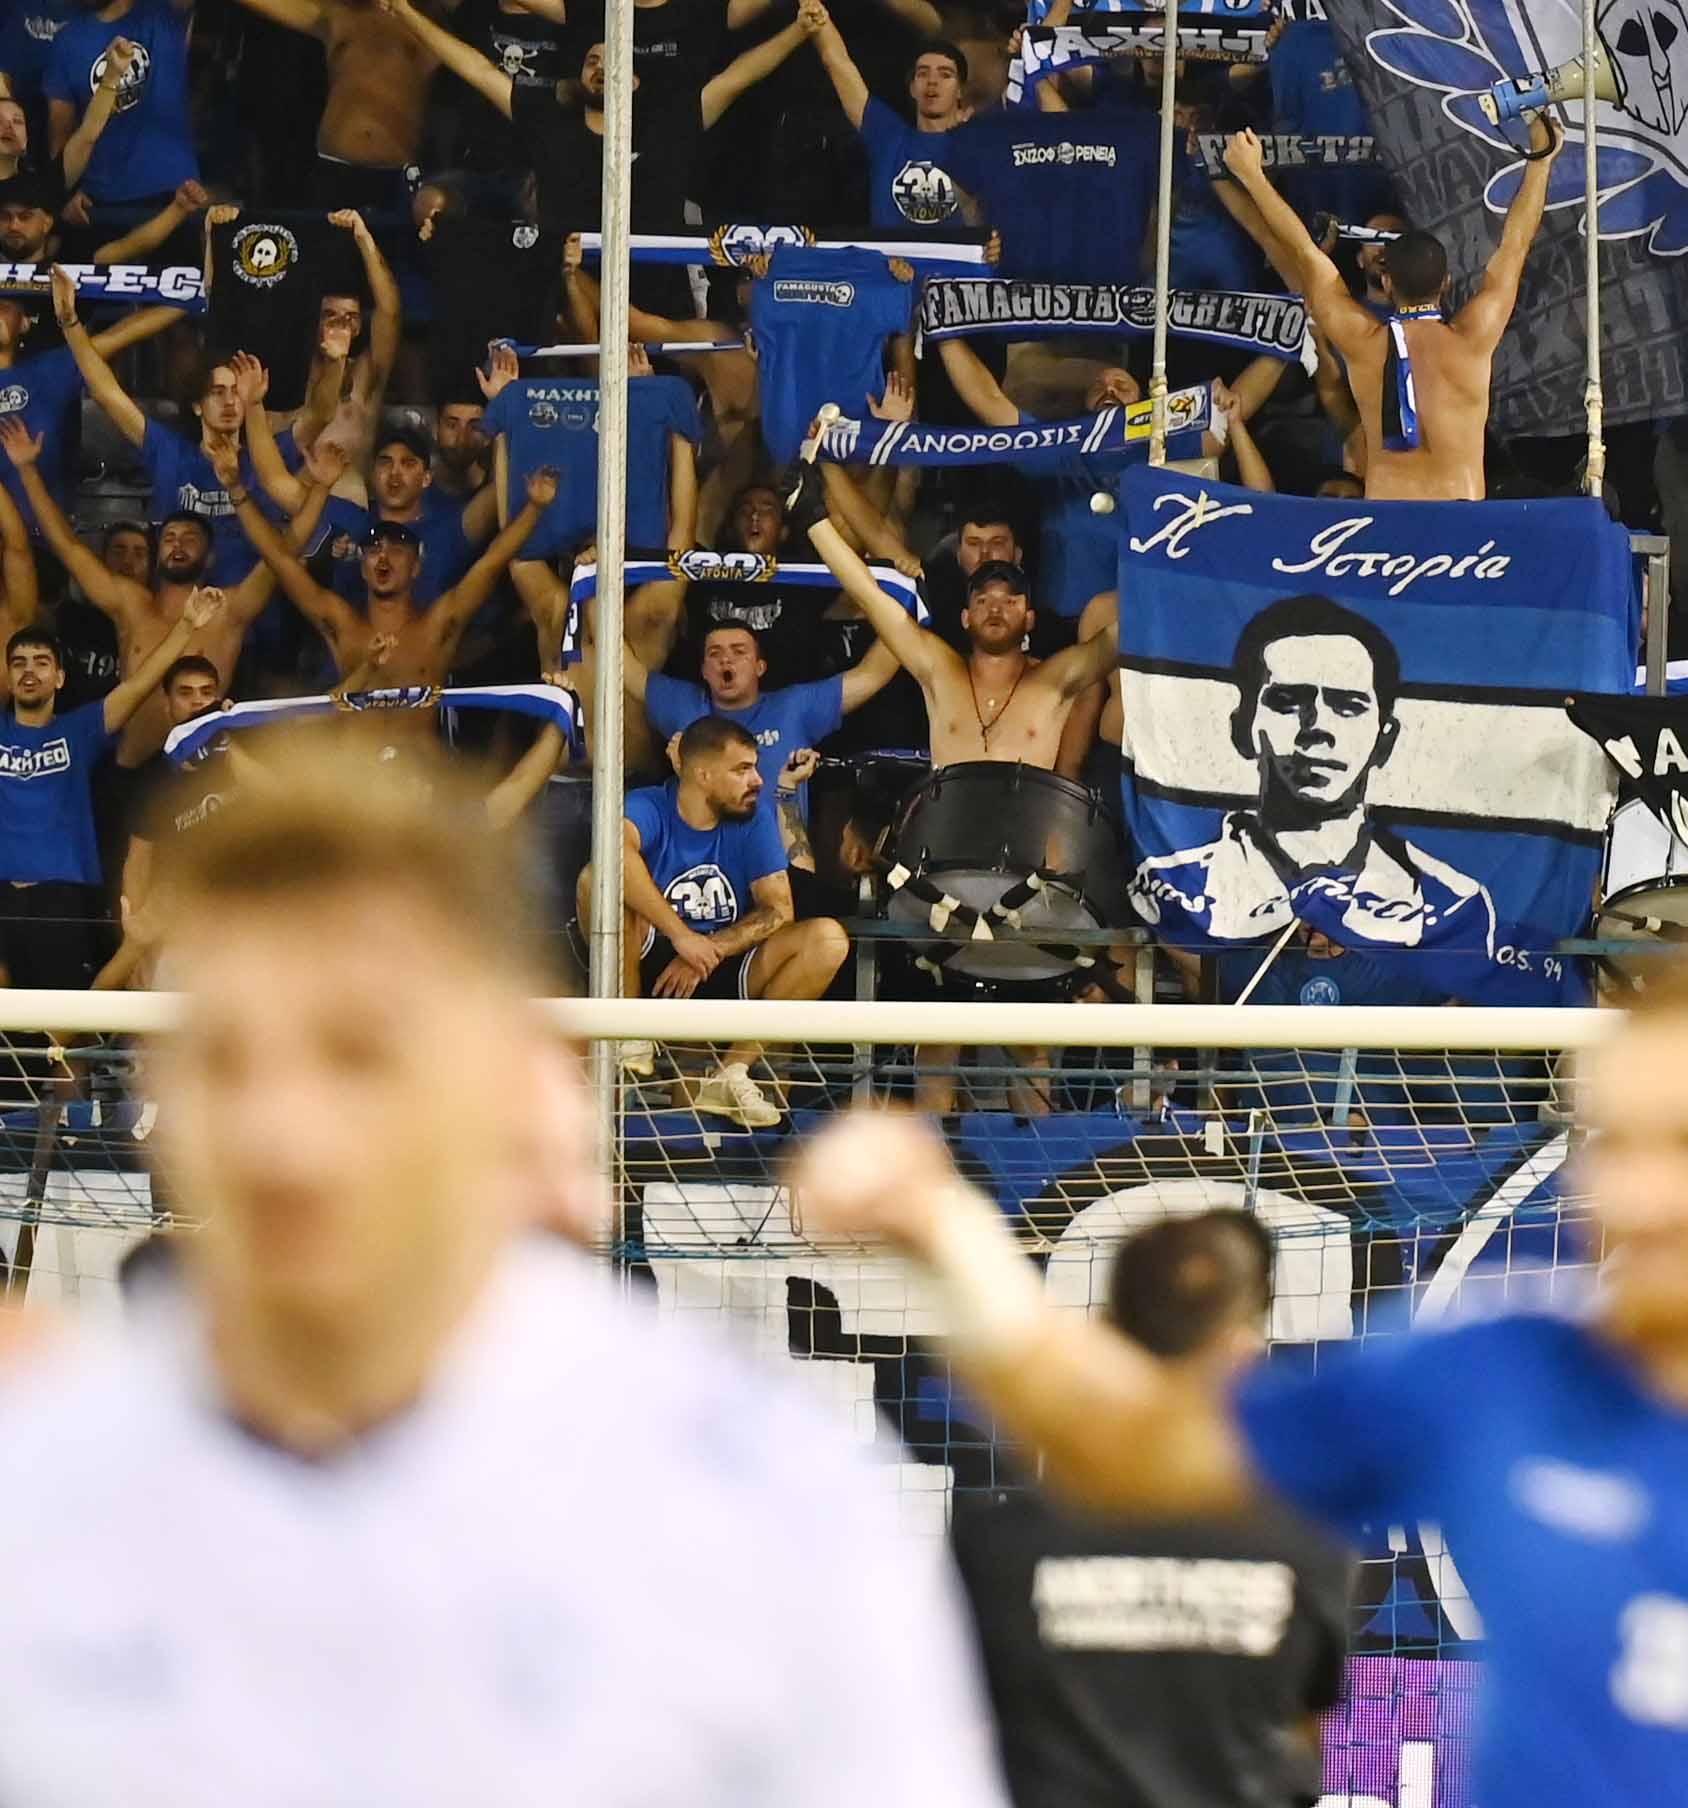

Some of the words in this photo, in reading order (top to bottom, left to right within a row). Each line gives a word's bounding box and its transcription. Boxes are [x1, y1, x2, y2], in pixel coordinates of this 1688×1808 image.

[925, 280, 1115, 328] FAMAGUSTA
[1170, 290, 1300, 346] GHETTO
[900, 423, 1082, 453] ΑΝΟΡΘΩΣΙΣ
[1273, 516, 1514, 596] Ιστορία
[668, 876, 732, 920] 30
